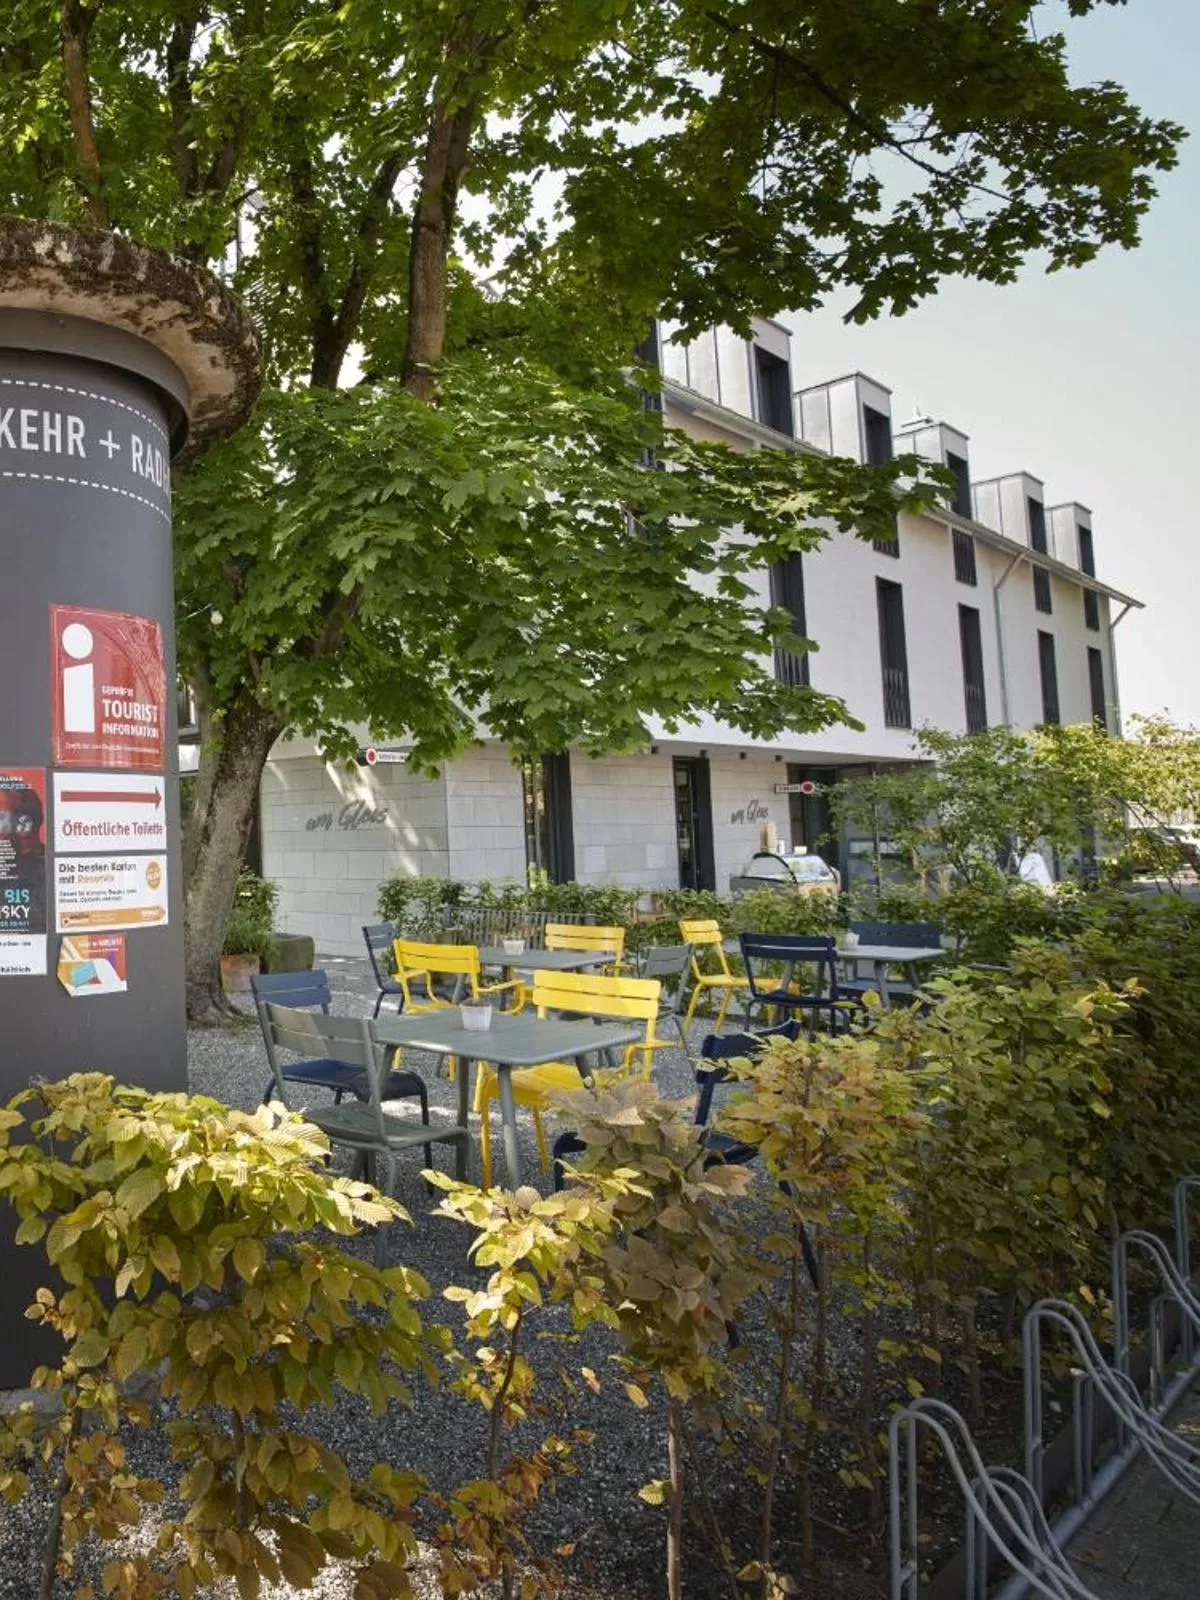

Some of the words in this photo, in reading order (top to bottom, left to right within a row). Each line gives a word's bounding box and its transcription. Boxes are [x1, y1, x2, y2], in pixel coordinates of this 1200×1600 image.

[102, 699, 158, 722] TOURIST
[102, 722, 159, 738] INFORMATION
[62, 819, 131, 836] Öffentliche
[59, 863, 75, 873] Die
[4, 889, 30, 903] BIS
